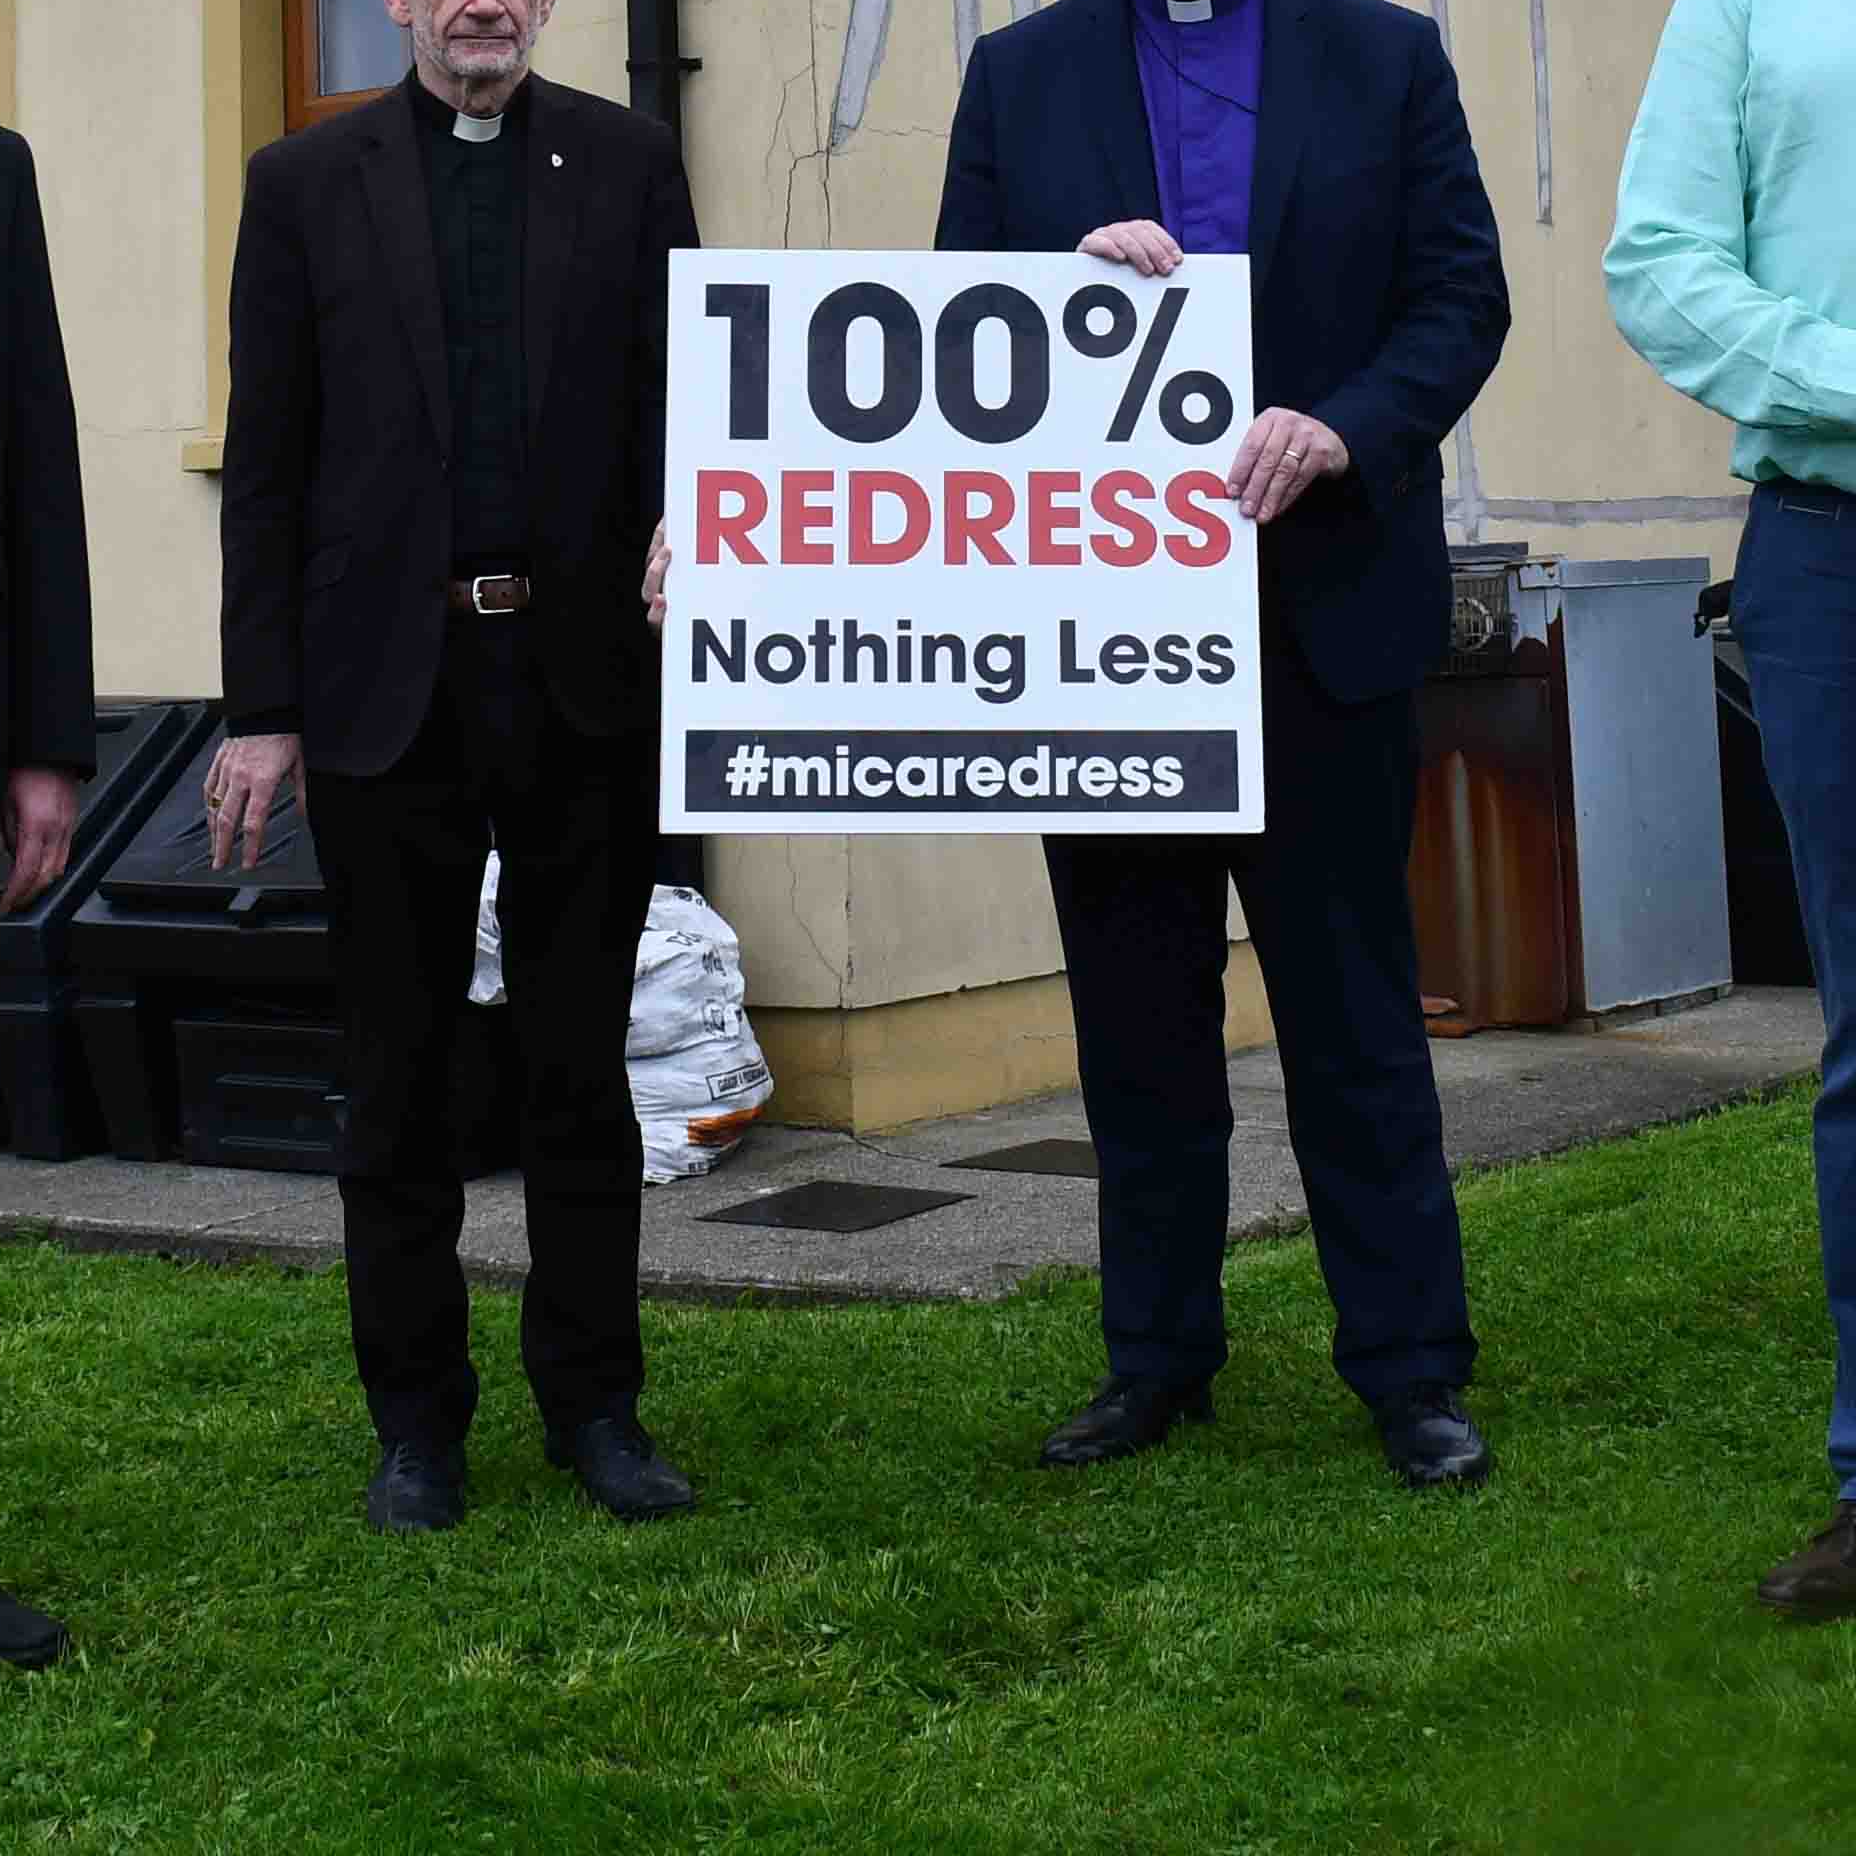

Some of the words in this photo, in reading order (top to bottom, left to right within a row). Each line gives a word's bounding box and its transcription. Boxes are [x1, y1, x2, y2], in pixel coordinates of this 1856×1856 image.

[705, 280, 1233, 445] 100%
[696, 470, 1231, 567] REDRESS
[692, 619, 1025, 704] Nothing
[1060, 620, 1235, 684] Less
[725, 744, 1184, 797] #micaredress
